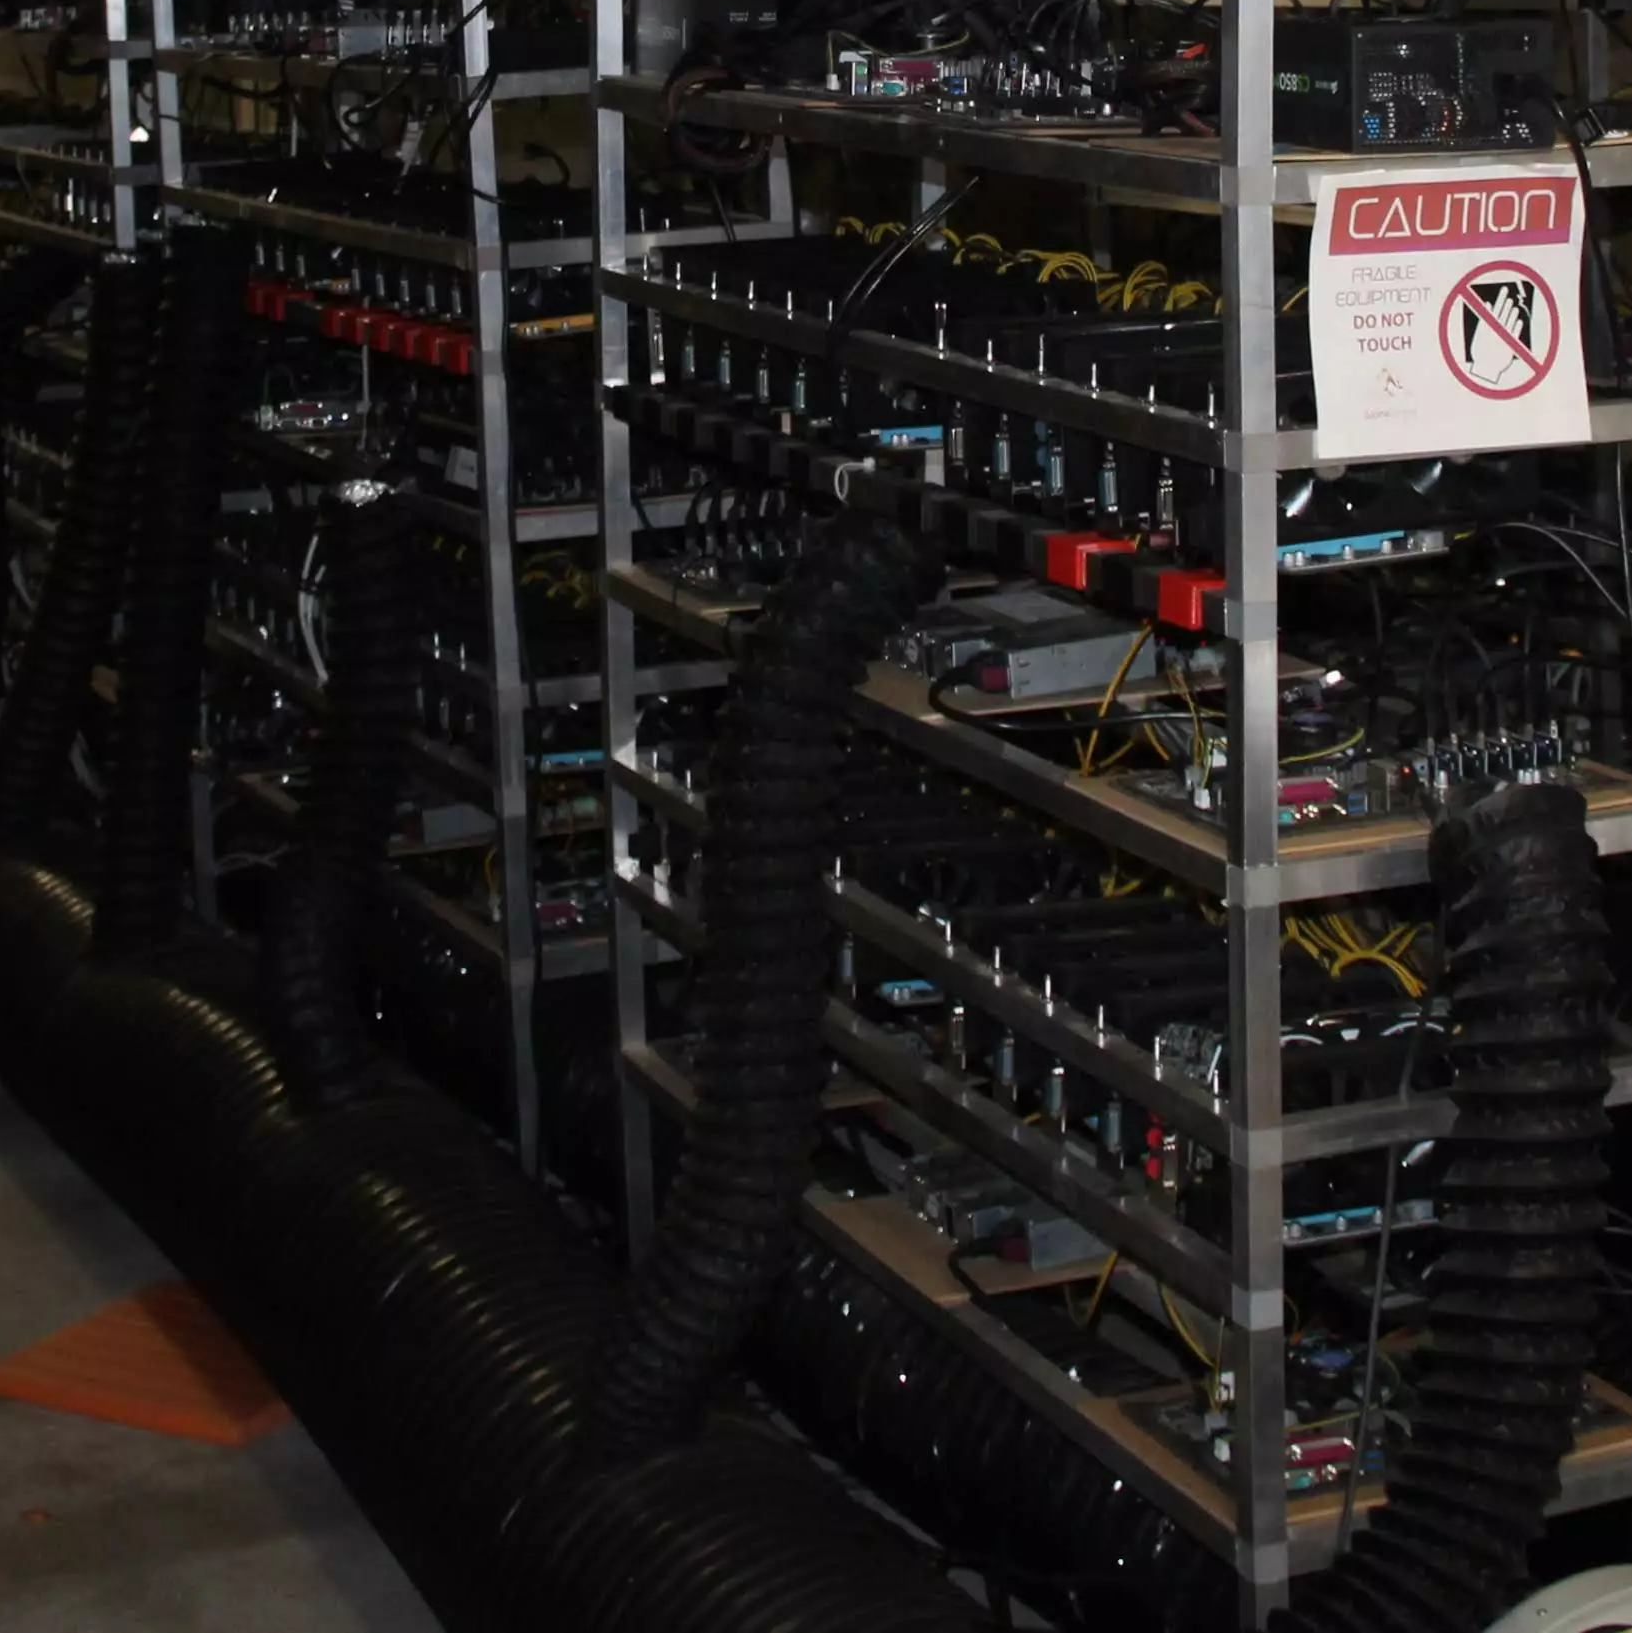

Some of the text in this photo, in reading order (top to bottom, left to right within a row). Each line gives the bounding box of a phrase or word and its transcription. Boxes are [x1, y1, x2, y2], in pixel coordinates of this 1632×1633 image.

[1349, 189, 1556, 239] CAUTION
[1351, 264, 1417, 283] FRAGILE
[1335, 286, 1431, 307] EQUIPMENT
[1353, 312, 1414, 329] DO NOT
[1357, 336, 1412, 353] TOUCH
